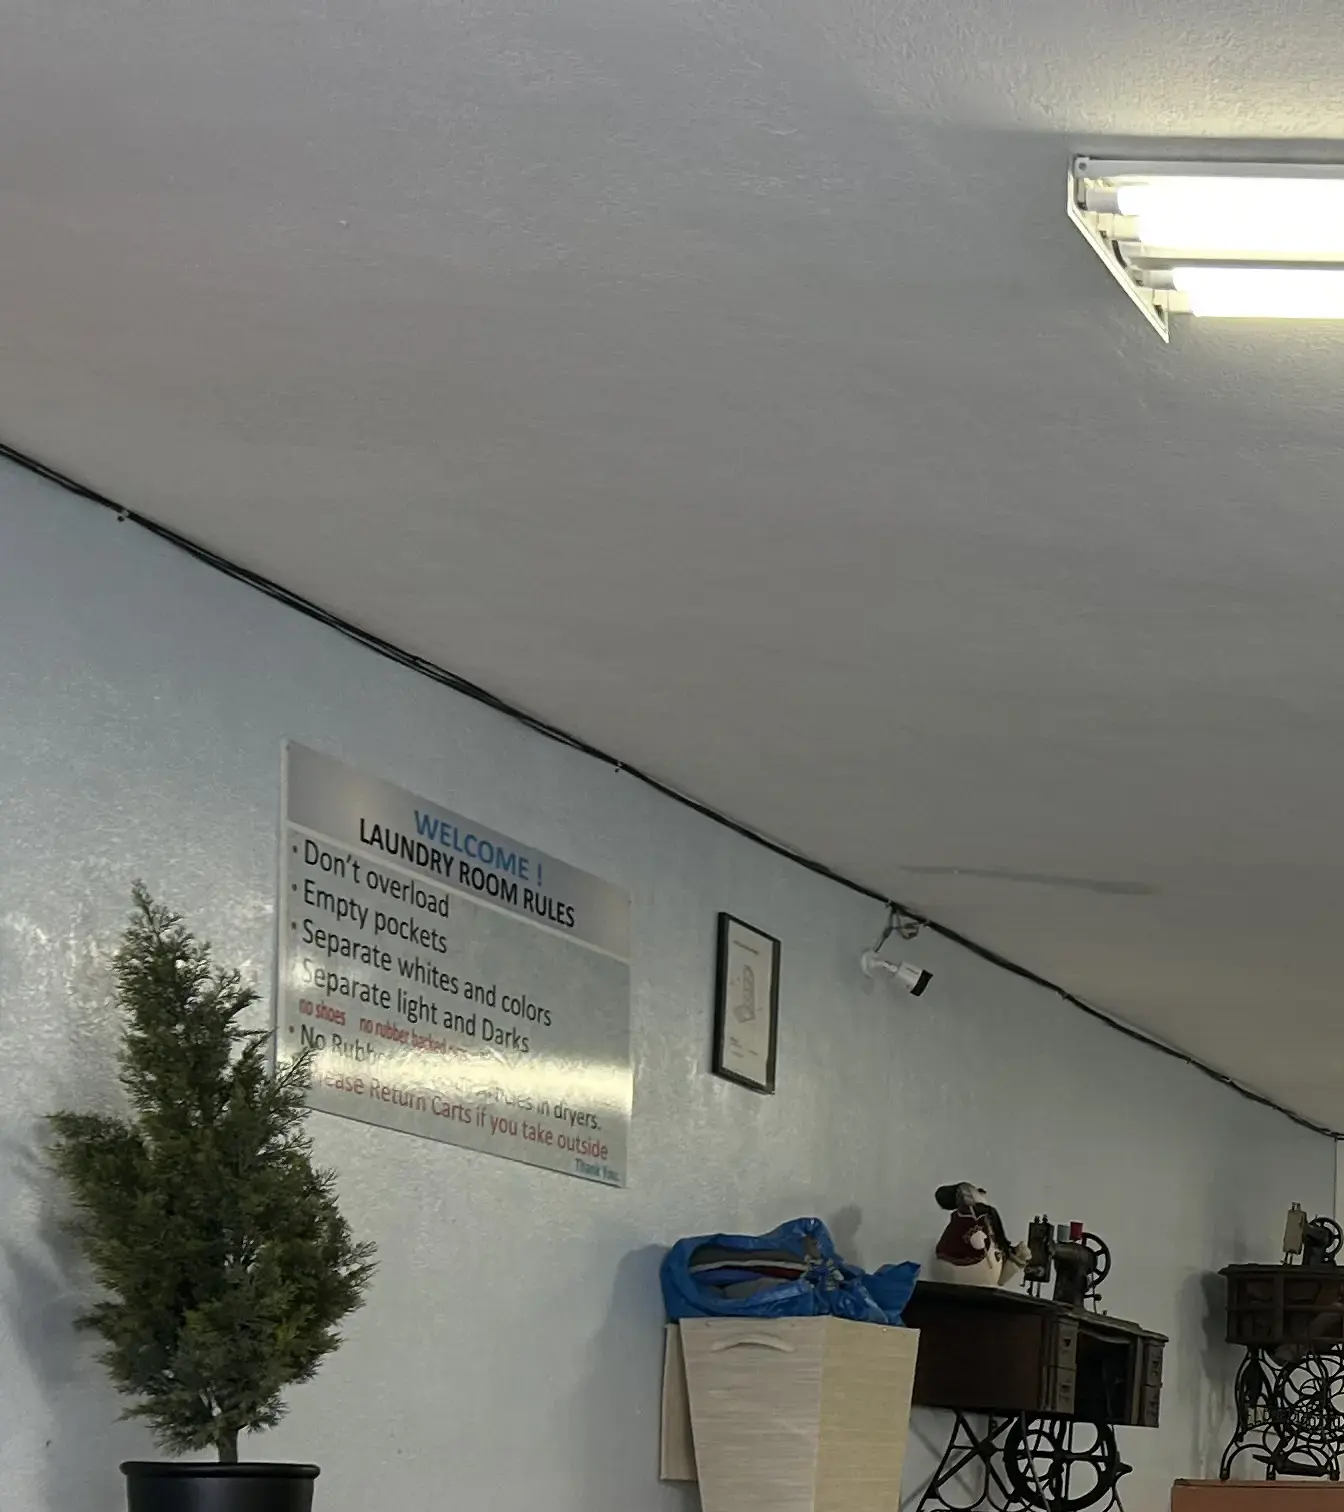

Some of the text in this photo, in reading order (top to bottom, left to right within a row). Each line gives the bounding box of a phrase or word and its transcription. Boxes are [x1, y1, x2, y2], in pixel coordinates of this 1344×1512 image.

[304, 839, 449, 918] Don't overload
[360, 818, 576, 928] LAUNDRY ROOM RULES
[414, 810, 529, 881] WELCOME
[304, 878, 448, 954] Empty pockets
[301, 957, 529, 1053] Separate light and Darks
[302, 918, 552, 1027] Separate whites and colors
[301, 1023, 327, 1051] No
[431, 1095, 472, 1124] Carts
[476, 1107, 487, 1127] if
[491, 1115, 517, 1135] you
[522, 1121, 553, 1145] take
[557, 1133, 609, 1160] outside
[553, 1100, 602, 1131] dryers.
